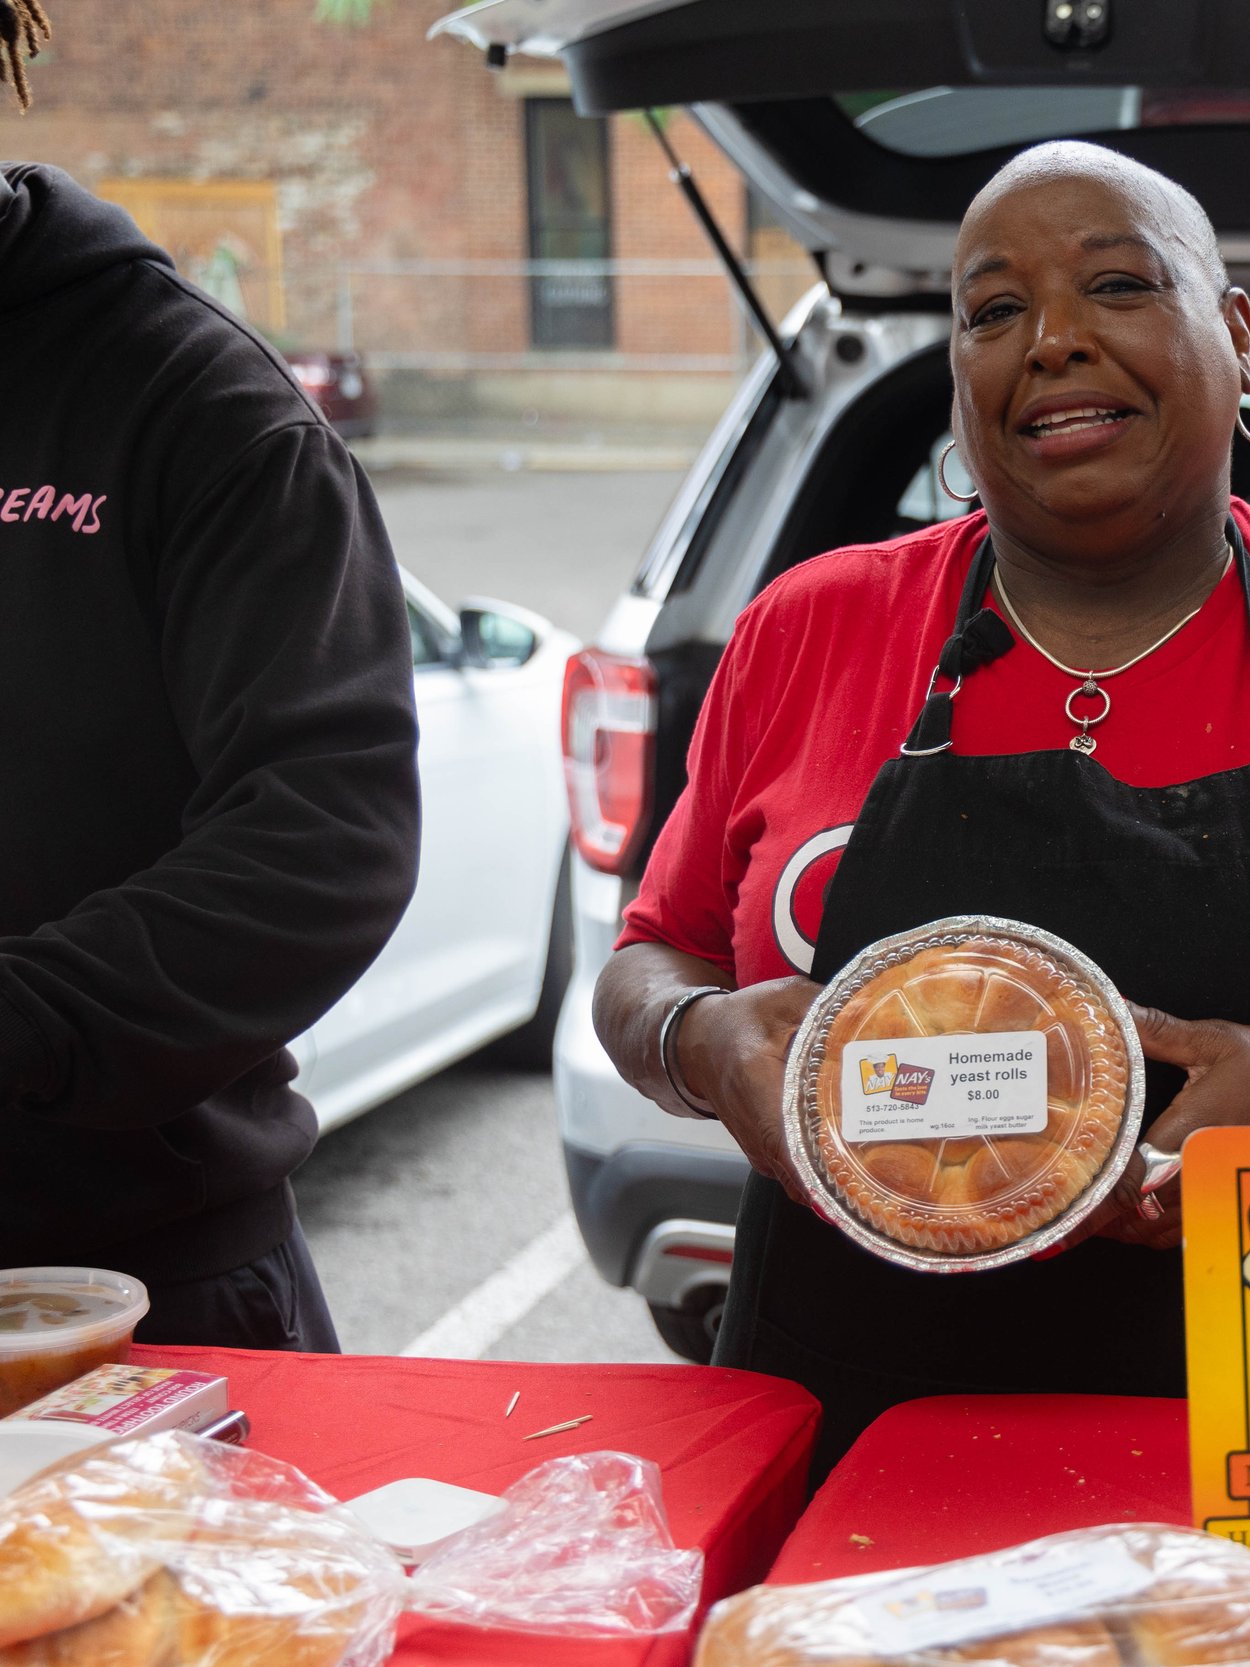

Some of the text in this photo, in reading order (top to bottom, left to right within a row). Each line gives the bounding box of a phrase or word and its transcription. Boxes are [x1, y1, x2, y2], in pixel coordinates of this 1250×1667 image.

[0, 485, 107, 534] EAMS
[949, 1049, 1033, 1064] Homemade
[865, 1072, 896, 1091] NAY
[896, 1071, 931, 1084] NAY's
[950, 1068, 1028, 1086] yeast rolls
[967, 1089, 999, 1101] $8.00
[866, 1103, 919, 1112] 513-720-5843
[873, 1118, 898, 1126] product
[163, 1381, 207, 1406] ROUND
[111, 1401, 168, 1435] TOOTHPIC
